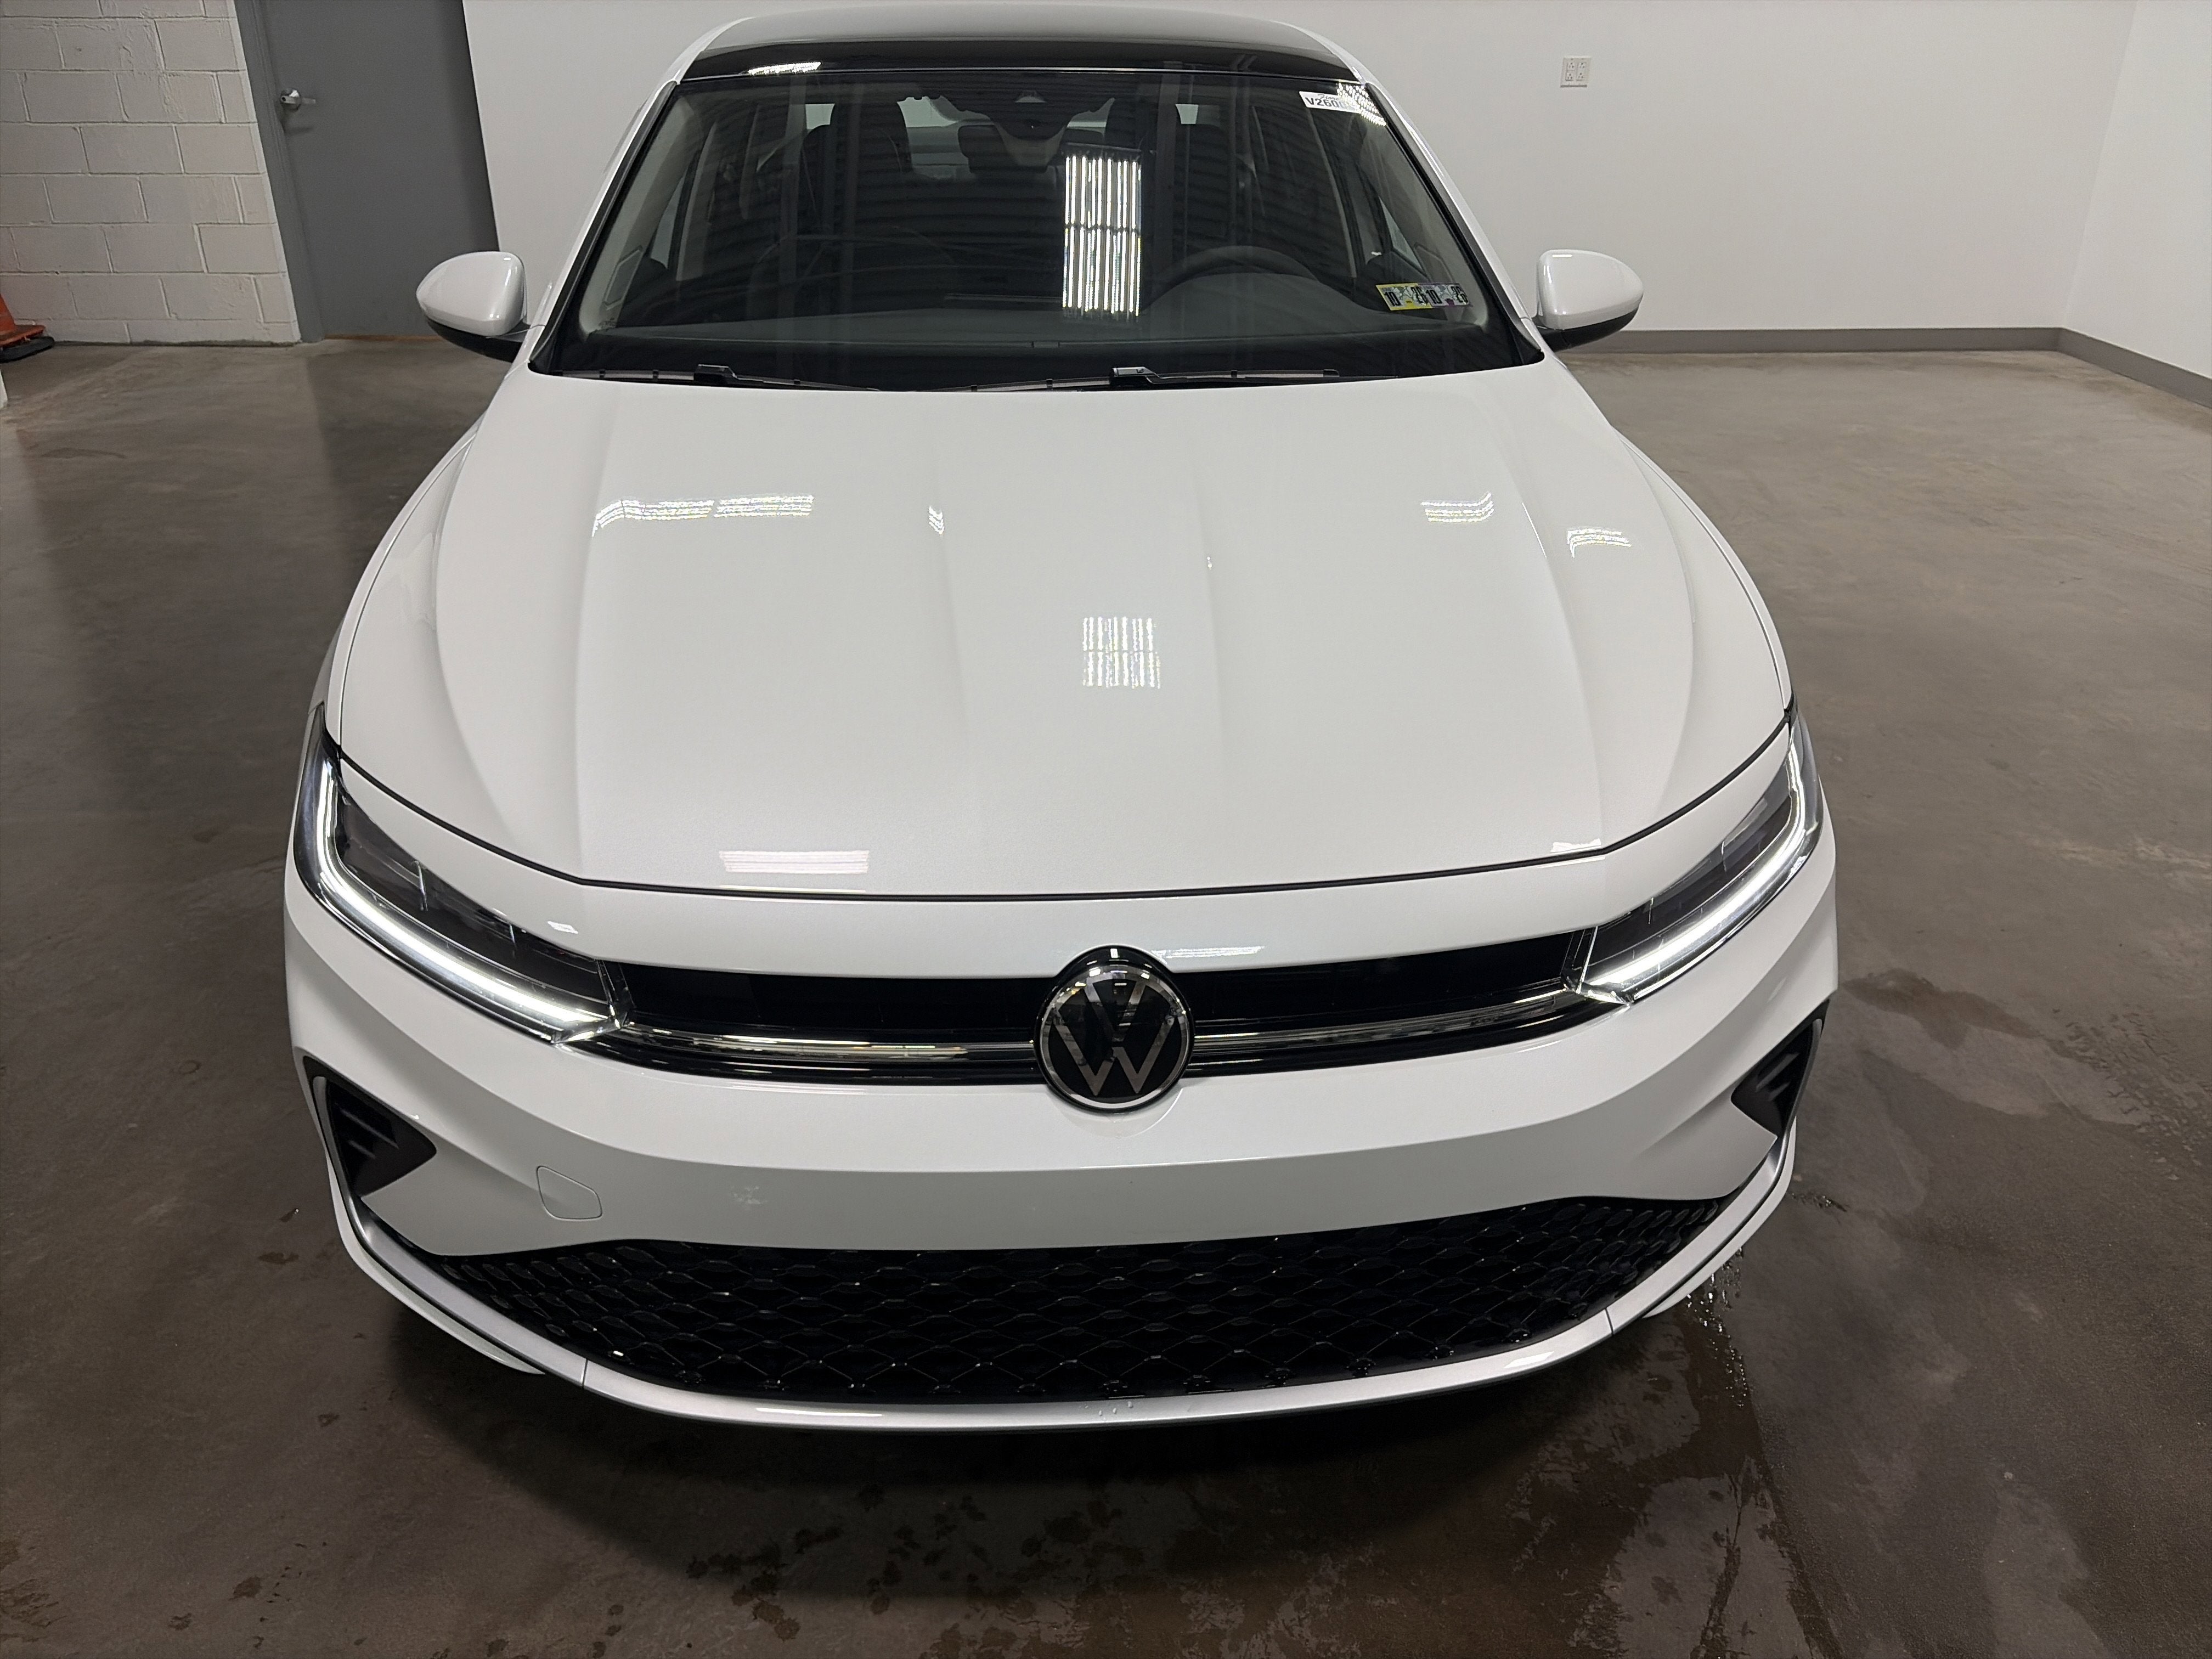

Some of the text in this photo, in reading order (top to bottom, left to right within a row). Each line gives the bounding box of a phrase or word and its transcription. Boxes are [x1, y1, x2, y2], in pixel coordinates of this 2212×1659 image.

[1384, 292, 1401, 306] 10
[1426, 290, 1442, 304] 10
[1053, 978, 1177, 1096] VW
